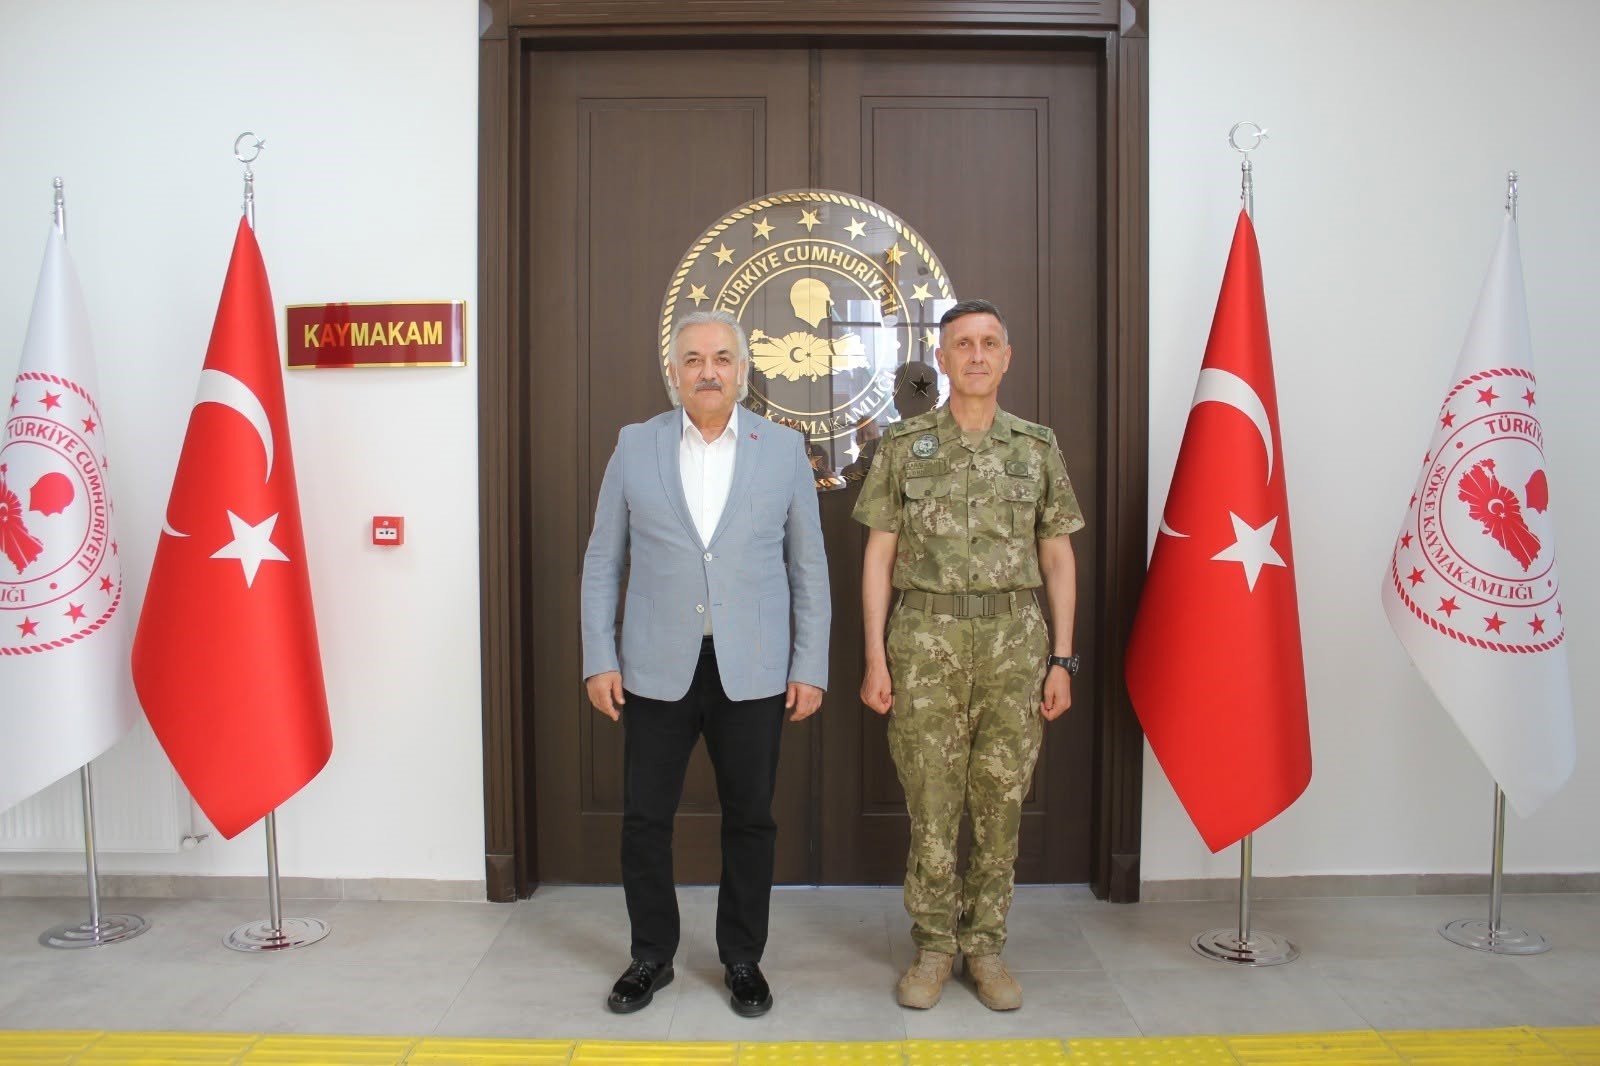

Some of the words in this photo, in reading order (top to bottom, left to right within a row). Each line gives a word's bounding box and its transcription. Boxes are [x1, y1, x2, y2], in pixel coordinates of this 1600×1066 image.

[720, 251, 782, 314] TÜRKİYE
[784, 245, 902, 315] CUMHURİYETİ
[304, 321, 443, 347] KAYMAKAM
[8, 419, 79, 454] TÜRKİYE
[75, 450, 106, 573] CUMHURİYETİ
[1424, 463, 1447, 512] SÖKE
[1423, 514, 1534, 600] KAYMAKAMLIĞI
